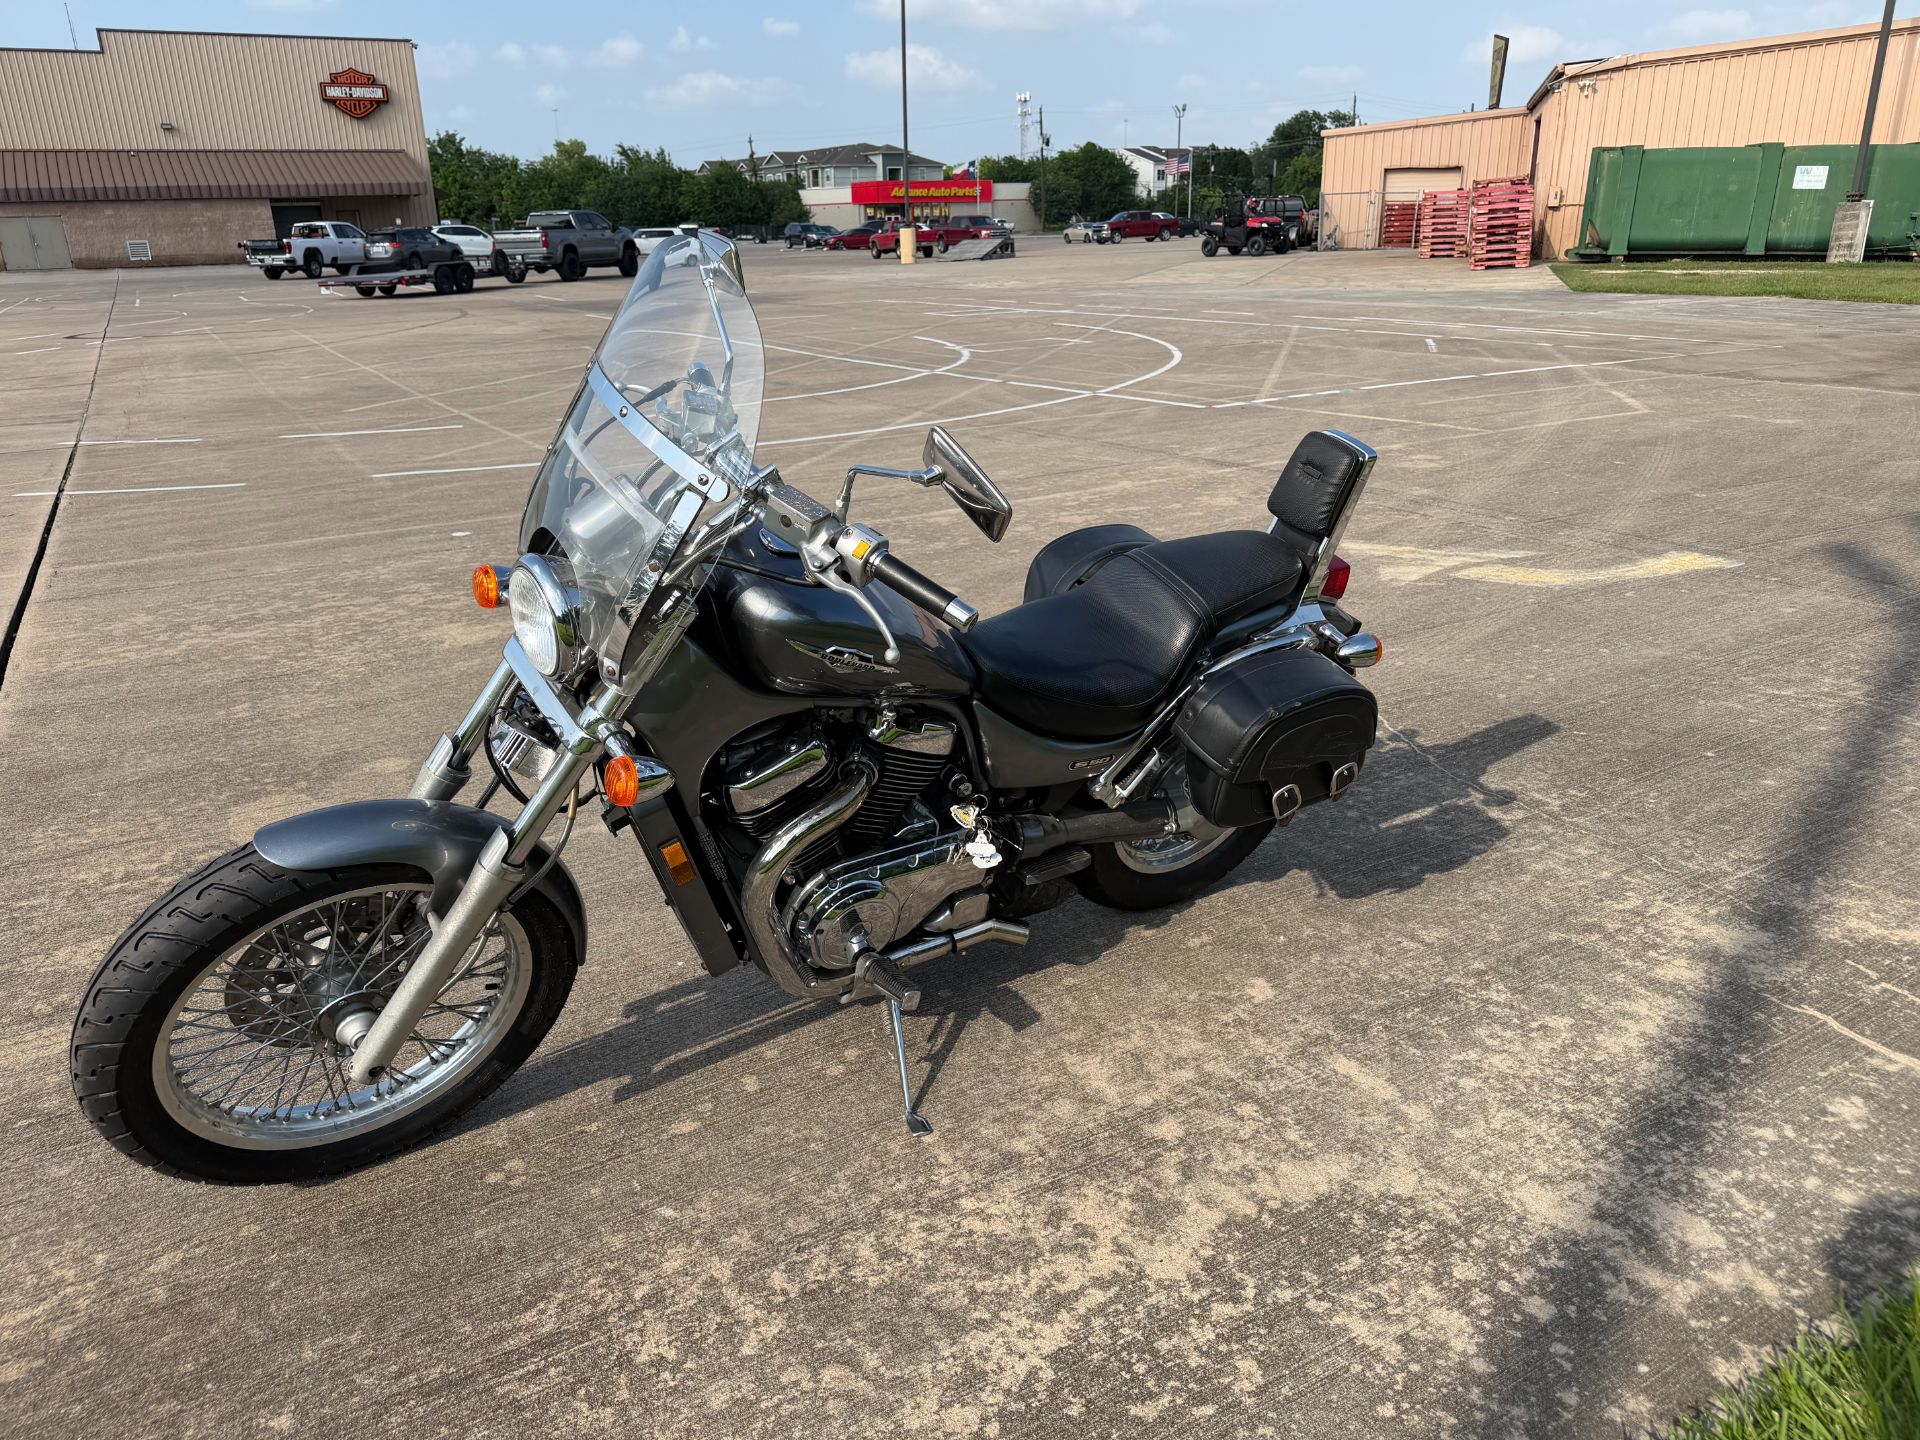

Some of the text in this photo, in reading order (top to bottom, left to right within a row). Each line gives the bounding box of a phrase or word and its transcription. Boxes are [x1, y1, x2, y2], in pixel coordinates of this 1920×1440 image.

[337, 74, 369, 84] MOTOR
[325, 86, 384, 99] HARLEY-DAVIDSON
[340, 100, 371, 114] CYCLES
[890, 186, 975, 197] Adance Auto Parts
[820, 653, 876, 671] BOULEVARD
